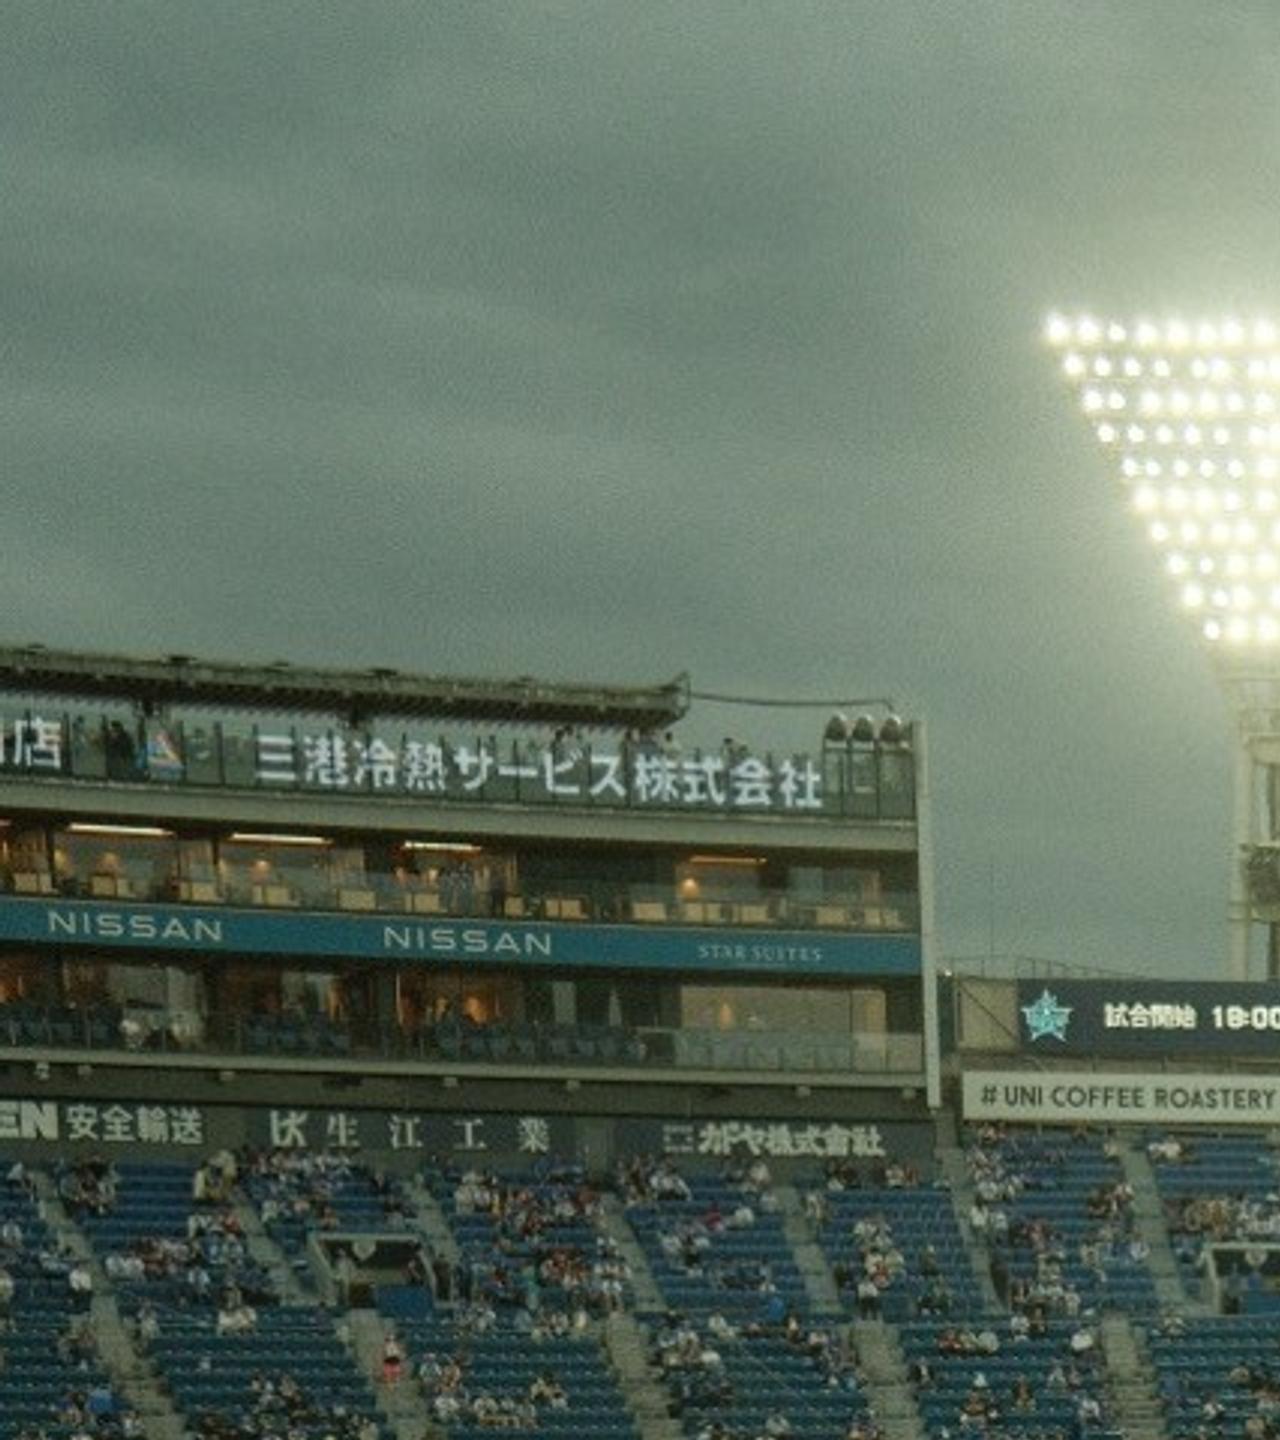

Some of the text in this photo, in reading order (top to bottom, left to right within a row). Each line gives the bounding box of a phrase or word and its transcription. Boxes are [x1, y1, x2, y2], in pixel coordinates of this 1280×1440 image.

[258, 734, 822, 808] 三港冷熱サービス株式会社
[49, 911, 223, 943] NISSAN
[384, 926, 551, 956] NISSAN
[699, 944, 822, 963] STAR SUITES
[1104, 1004, 1197, 1028] 試合開始
[1052, 1086, 1144, 1108] COFFEE
[1155, 1087, 1276, 1109] ROASTERY
[67, 1105, 201, 1144] 安全輸送
